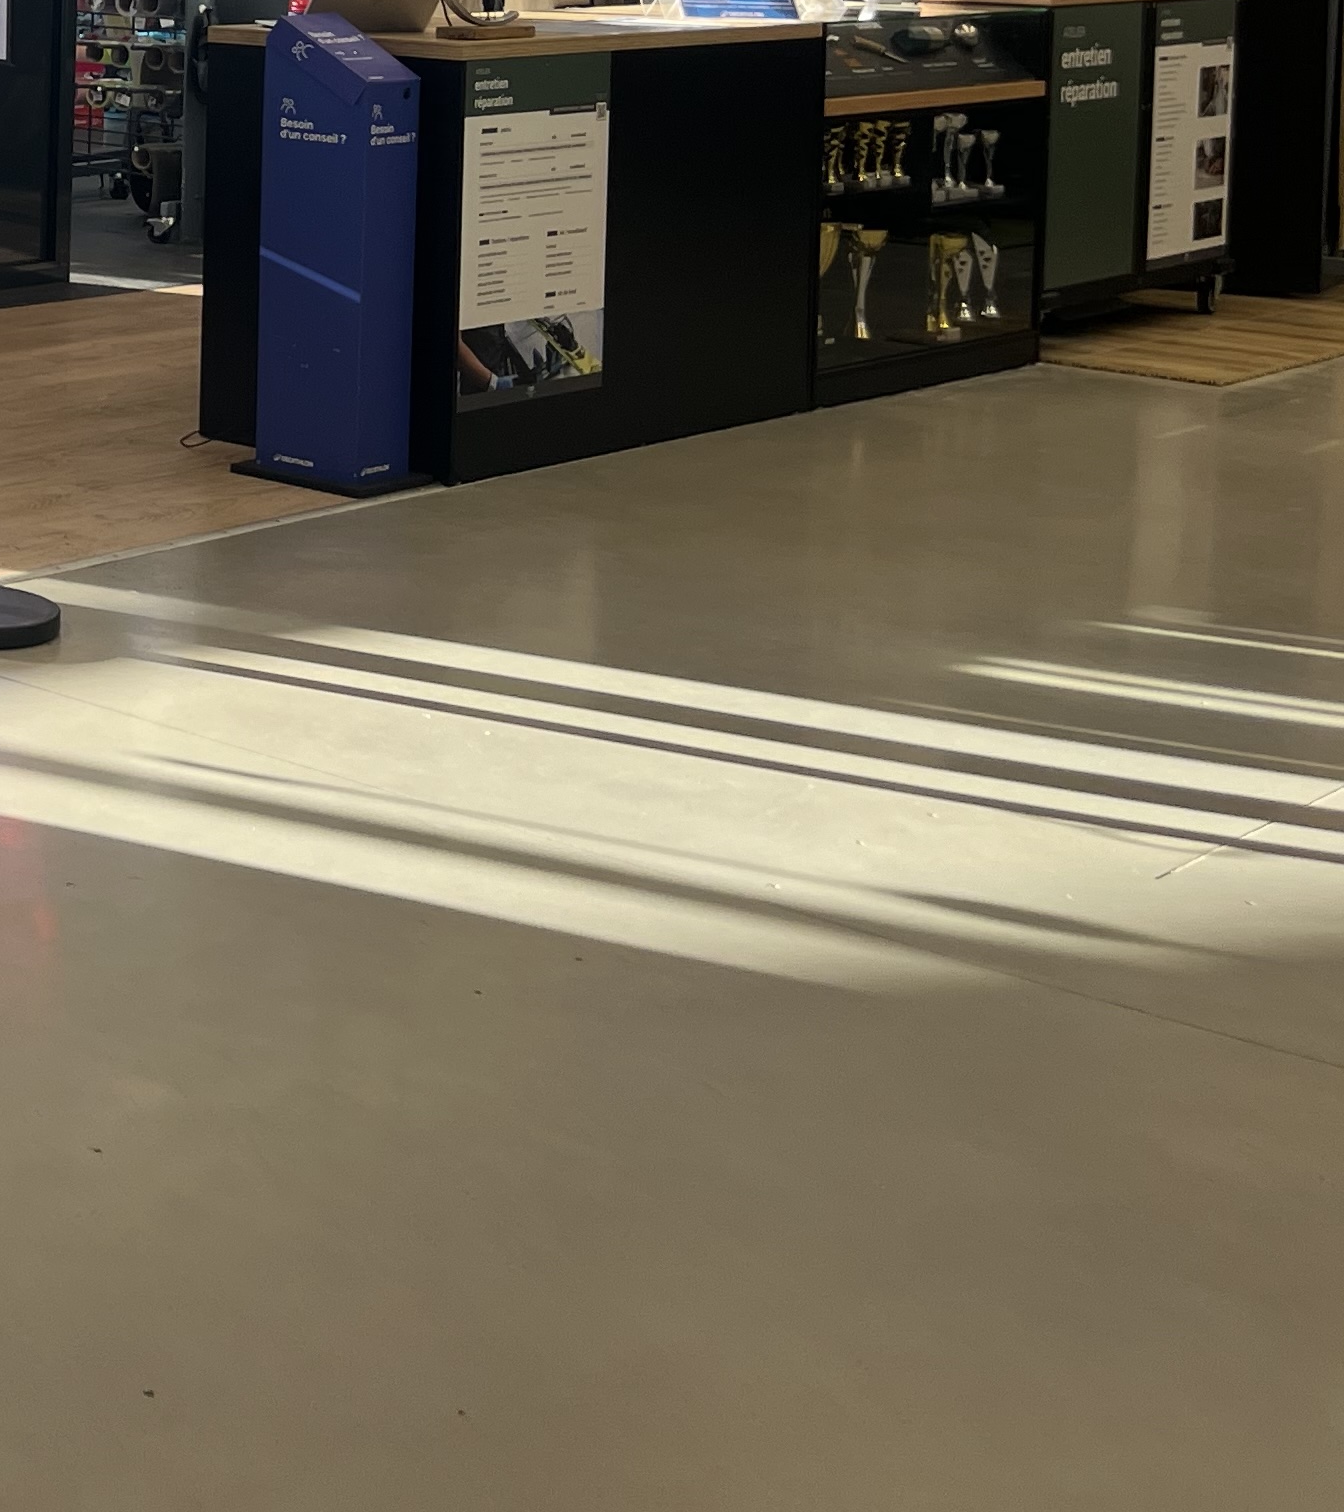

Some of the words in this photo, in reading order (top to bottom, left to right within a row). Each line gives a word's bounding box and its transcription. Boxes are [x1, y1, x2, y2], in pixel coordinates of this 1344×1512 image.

[1061, 42, 1112, 69] entretien
[474, 77, 509, 91] entretien
[1060, 75, 1118, 107] réparation
[474, 93, 513, 111] réparation
[280, 117, 314, 130] Besoin
[280, 129, 301, 139] d'un
[303, 132, 338, 144] conseil
[340, 134, 347, 144] ?
